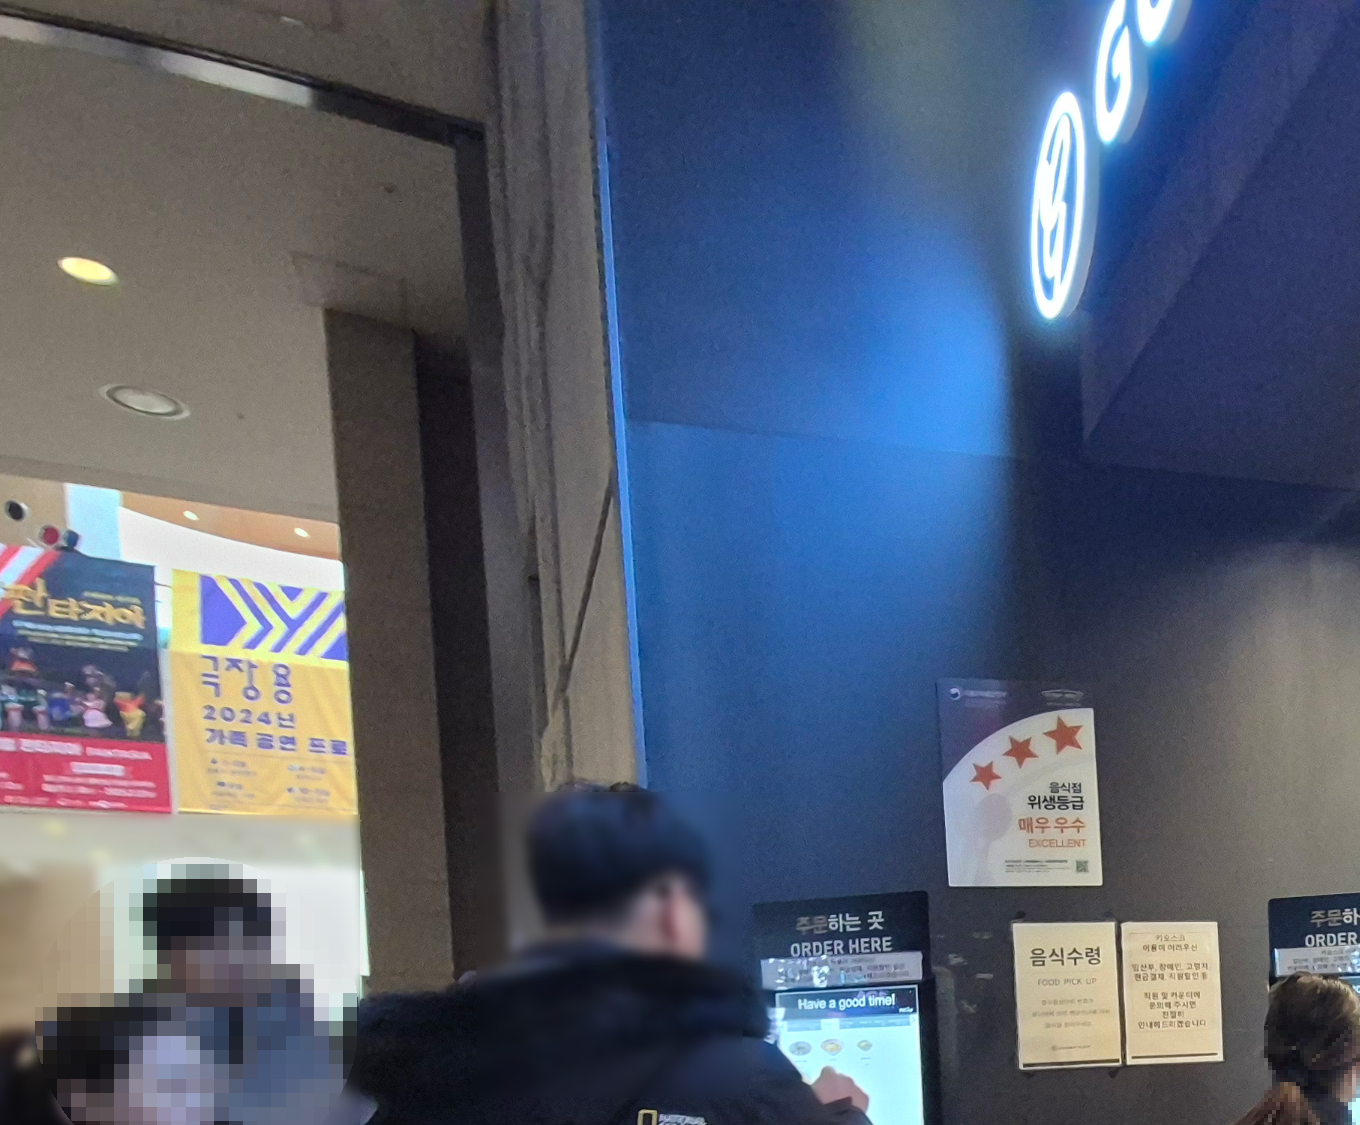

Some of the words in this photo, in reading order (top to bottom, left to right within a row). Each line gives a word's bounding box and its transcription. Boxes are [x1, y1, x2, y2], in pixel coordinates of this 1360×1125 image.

[200, 655, 261, 702] 극장
[272, 663, 293, 704] 용
[203, 704, 296, 729] 2024년
[1049, 782, 1082, 794] 음식점
[1027, 795, 1085, 811] 위생등급
[1018, 817, 1051, 834] 매우
[1053, 817, 1086, 834] 우수
[1028, 839, 1087, 849] EXCELLENT
[796, 912, 863, 935] 주문하는
[867, 910, 885, 931] 곳
[790, 941, 845, 958] ORDER
[849, 936, 893, 955] HERE
[1304, 931, 1358, 948] ORDER
[1029, 946, 1102, 967] 음식수령
[1086, 977, 1097, 985] UP
[798, 998, 827, 1010] Have
[828, 1000, 837, 1008] a
[838, 996, 866, 1011] good
[868, 993, 896, 1006] time!
